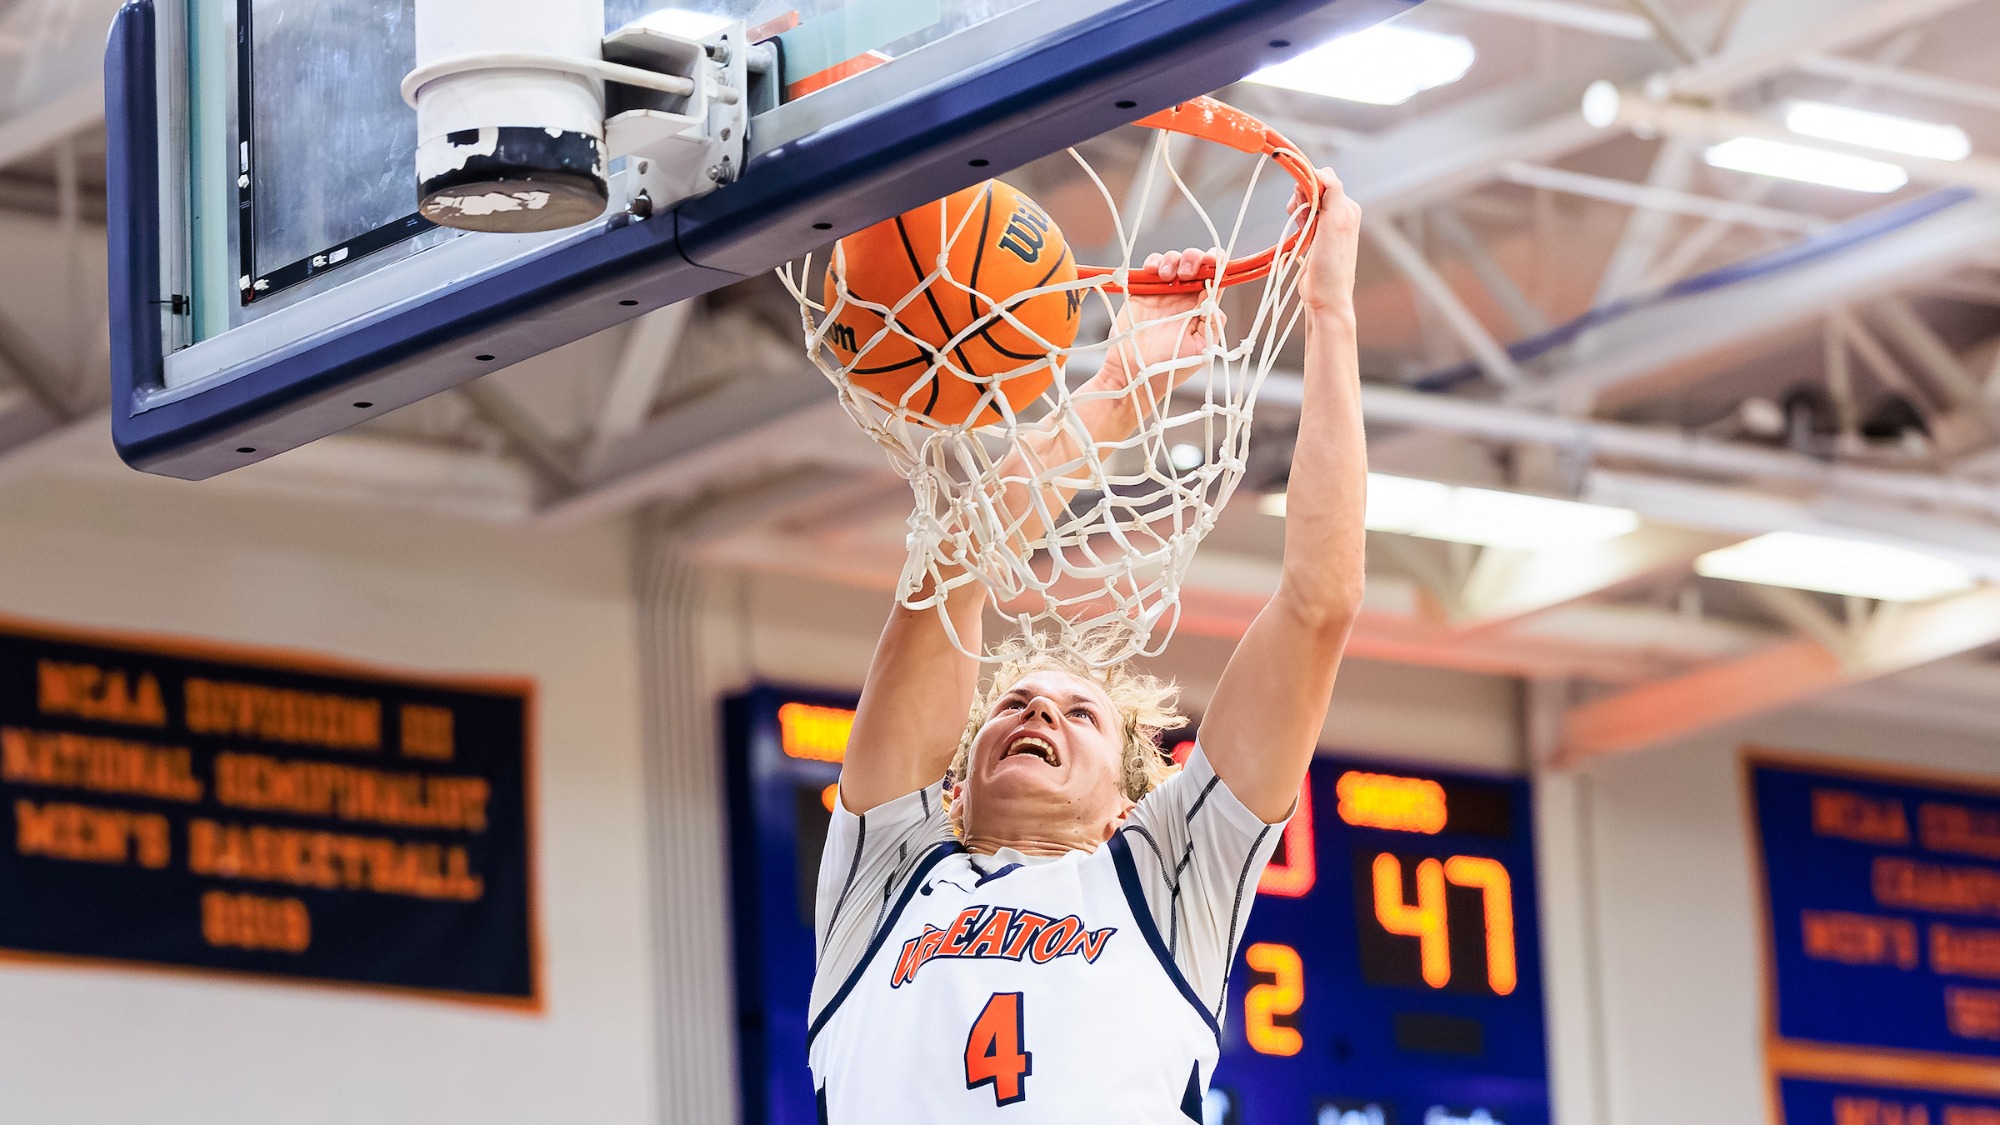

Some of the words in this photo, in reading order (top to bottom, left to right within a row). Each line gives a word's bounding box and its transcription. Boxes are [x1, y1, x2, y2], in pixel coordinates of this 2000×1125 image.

[1, 726, 203, 802] NATIONAL
[184, 678, 381, 751] DIVISION
[16, 800, 170, 868] MEN'S
[188, 819, 483, 902] BASKETBALL
[1372, 852, 1517, 996] 47
[964, 992, 1032, 1107] 4
[1244, 942, 1304, 1057] 2
